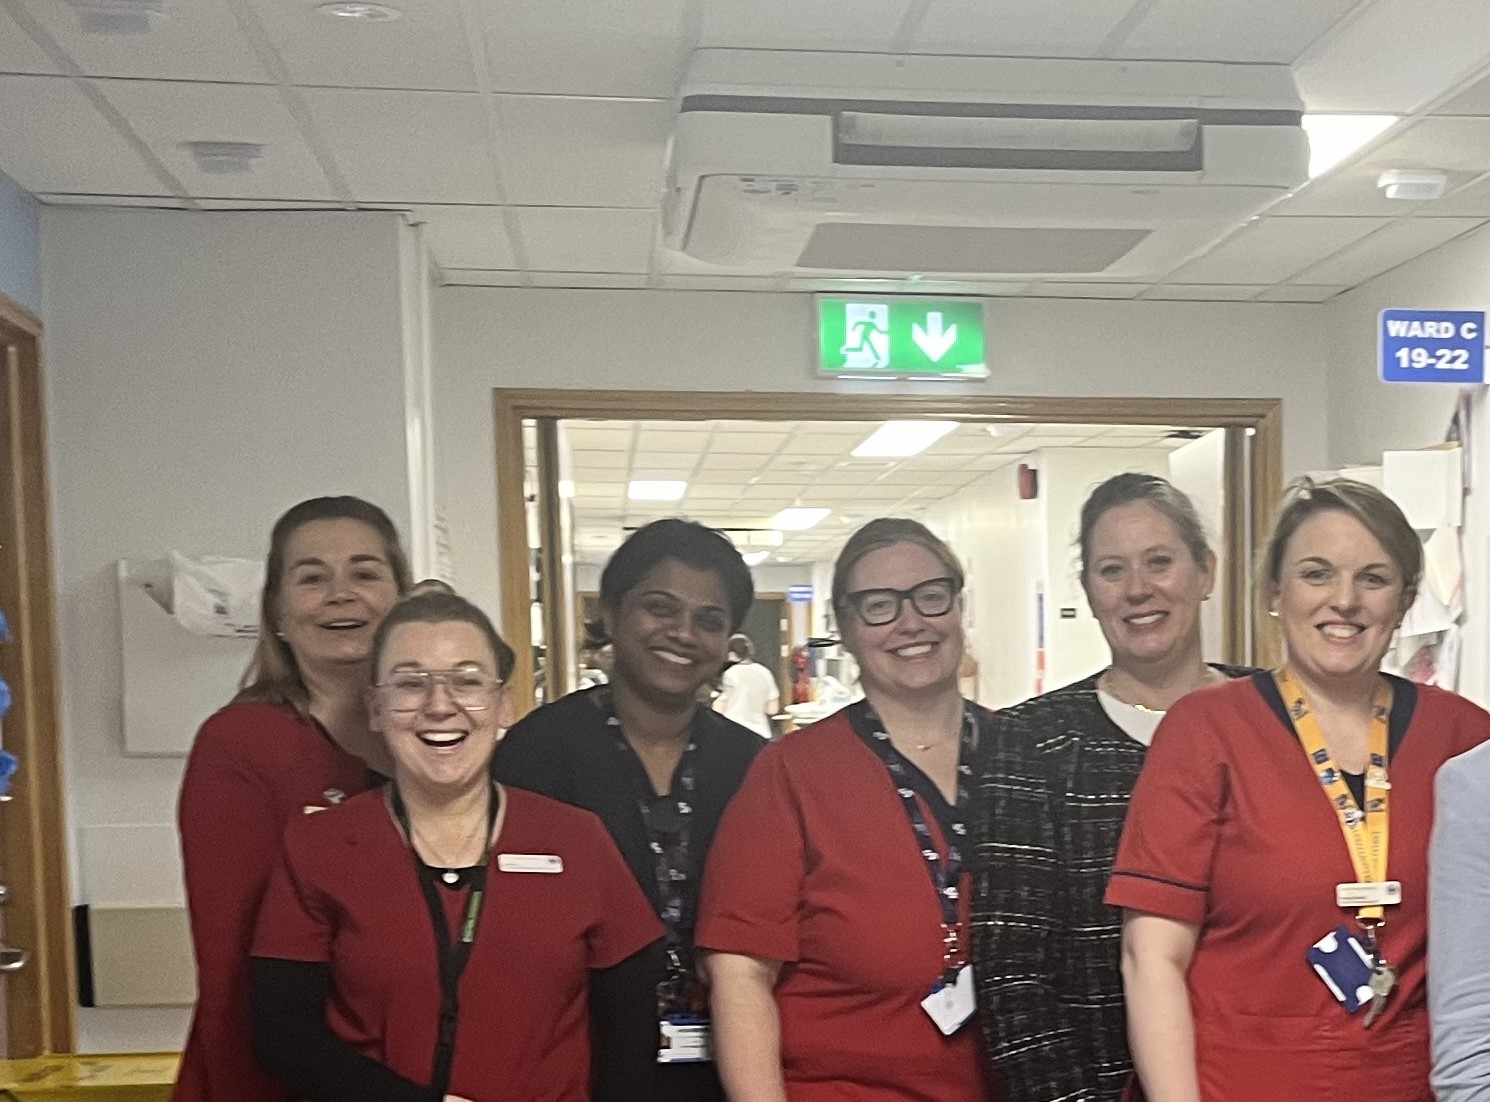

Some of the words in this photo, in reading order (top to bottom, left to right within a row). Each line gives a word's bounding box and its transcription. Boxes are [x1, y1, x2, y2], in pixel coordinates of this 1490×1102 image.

[1386, 320, 1456, 339] WARD
[1460, 322, 1478, 340] C
[1395, 347, 1470, 370] 19-22
